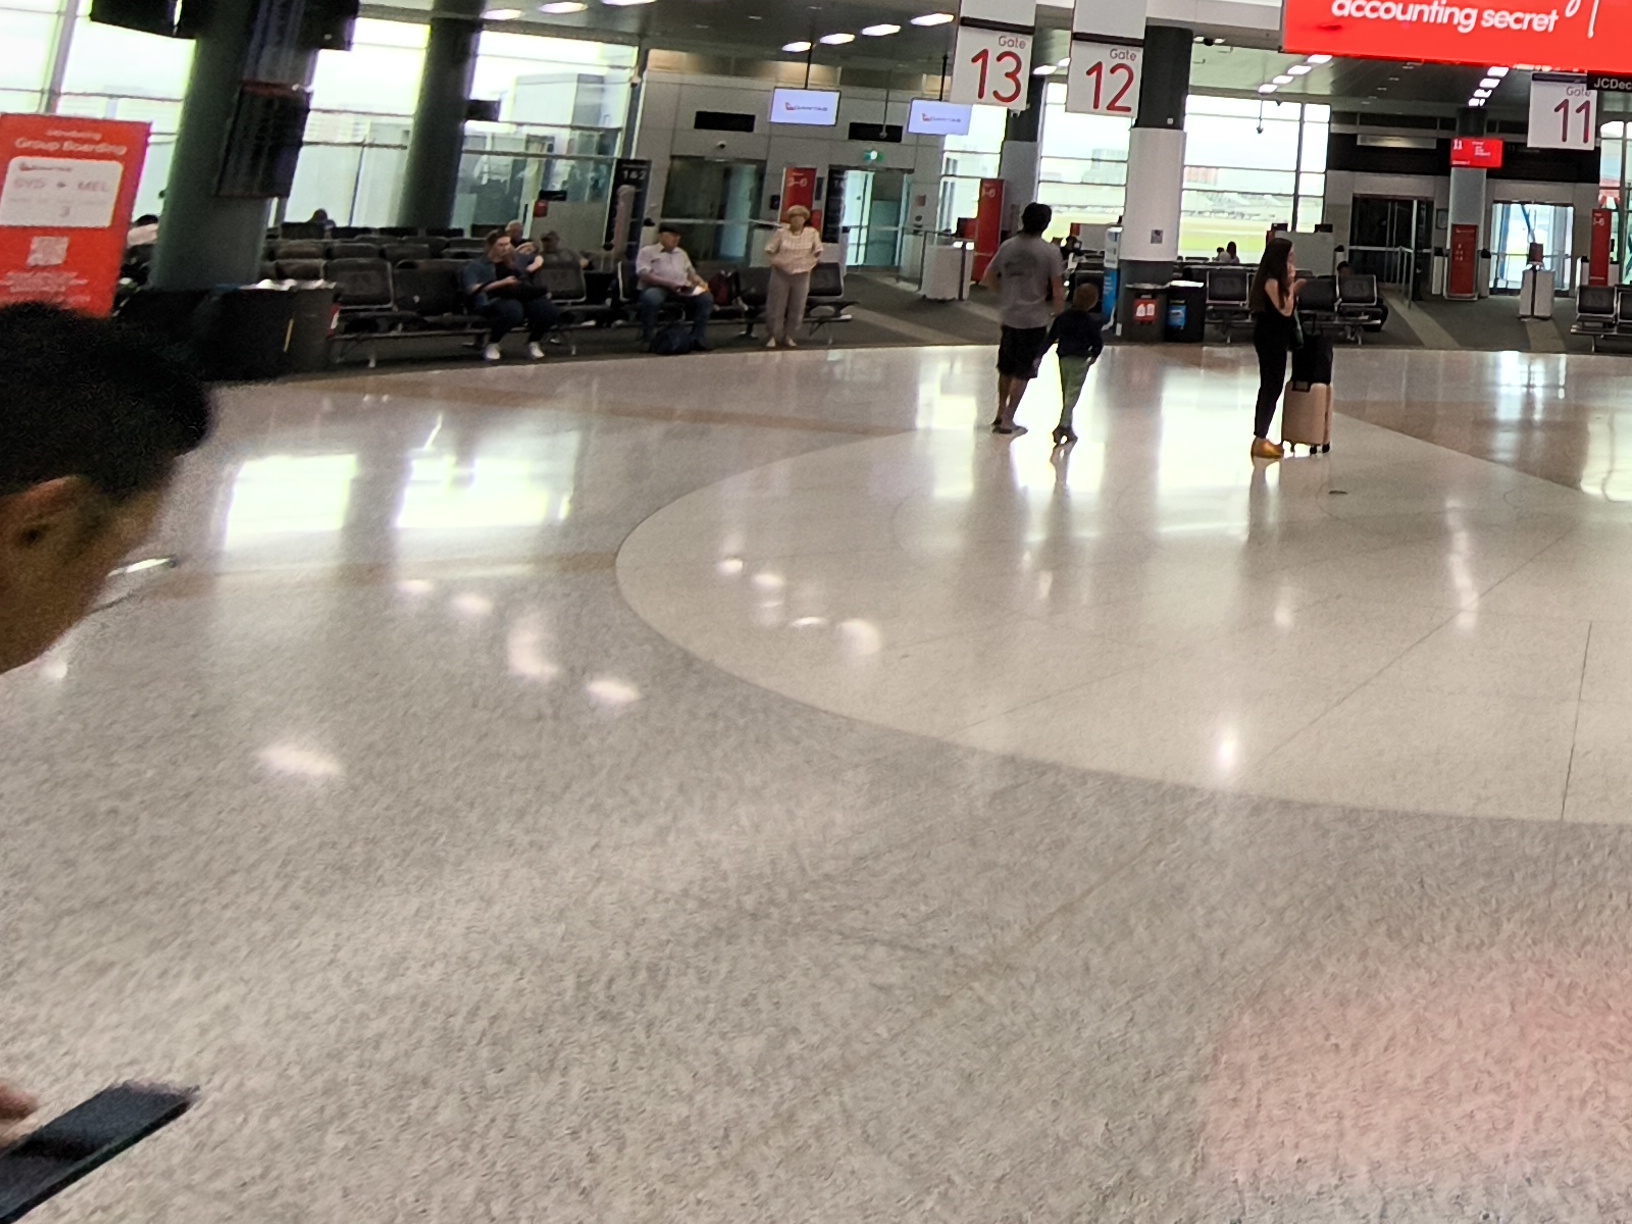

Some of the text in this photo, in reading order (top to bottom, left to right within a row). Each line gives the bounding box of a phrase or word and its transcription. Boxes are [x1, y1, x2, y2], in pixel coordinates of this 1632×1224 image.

[1481, 5, 1559, 33] secret
[998, 35, 1027, 49] Gate
[1109, 48, 1137, 62] Gate
[971, 48, 1022, 103] 13
[1085, 60, 1135, 113] 12
[1553, 98, 1591, 144] 11
[62, 140, 128, 156] Boarding
